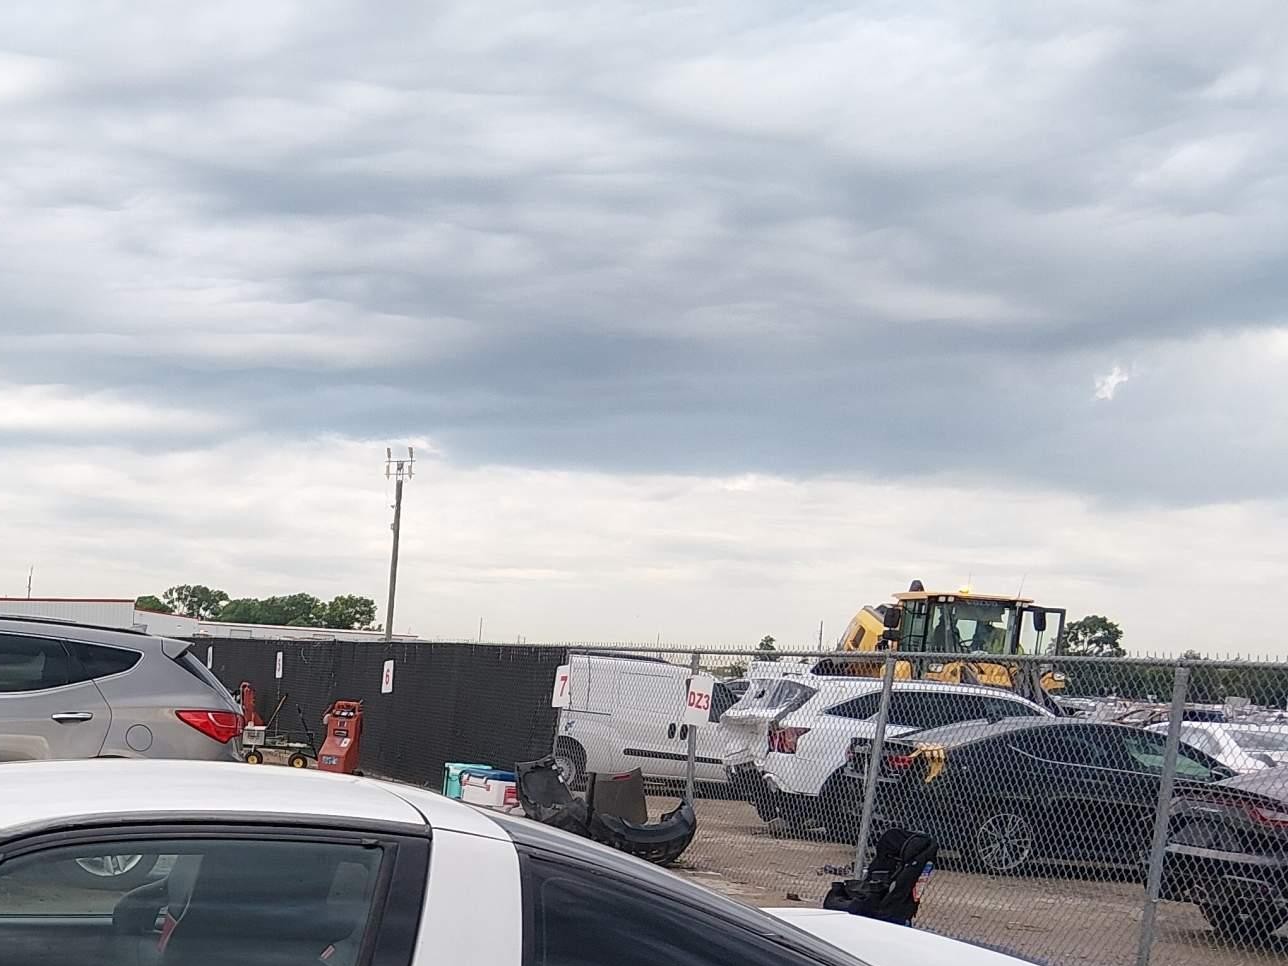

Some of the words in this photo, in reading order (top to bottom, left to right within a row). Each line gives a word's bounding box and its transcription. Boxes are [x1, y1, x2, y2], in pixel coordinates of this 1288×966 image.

[384, 668, 391, 686] 6
[559, 675, 568, 697] 7
[687, 691, 711, 711] DZ3
